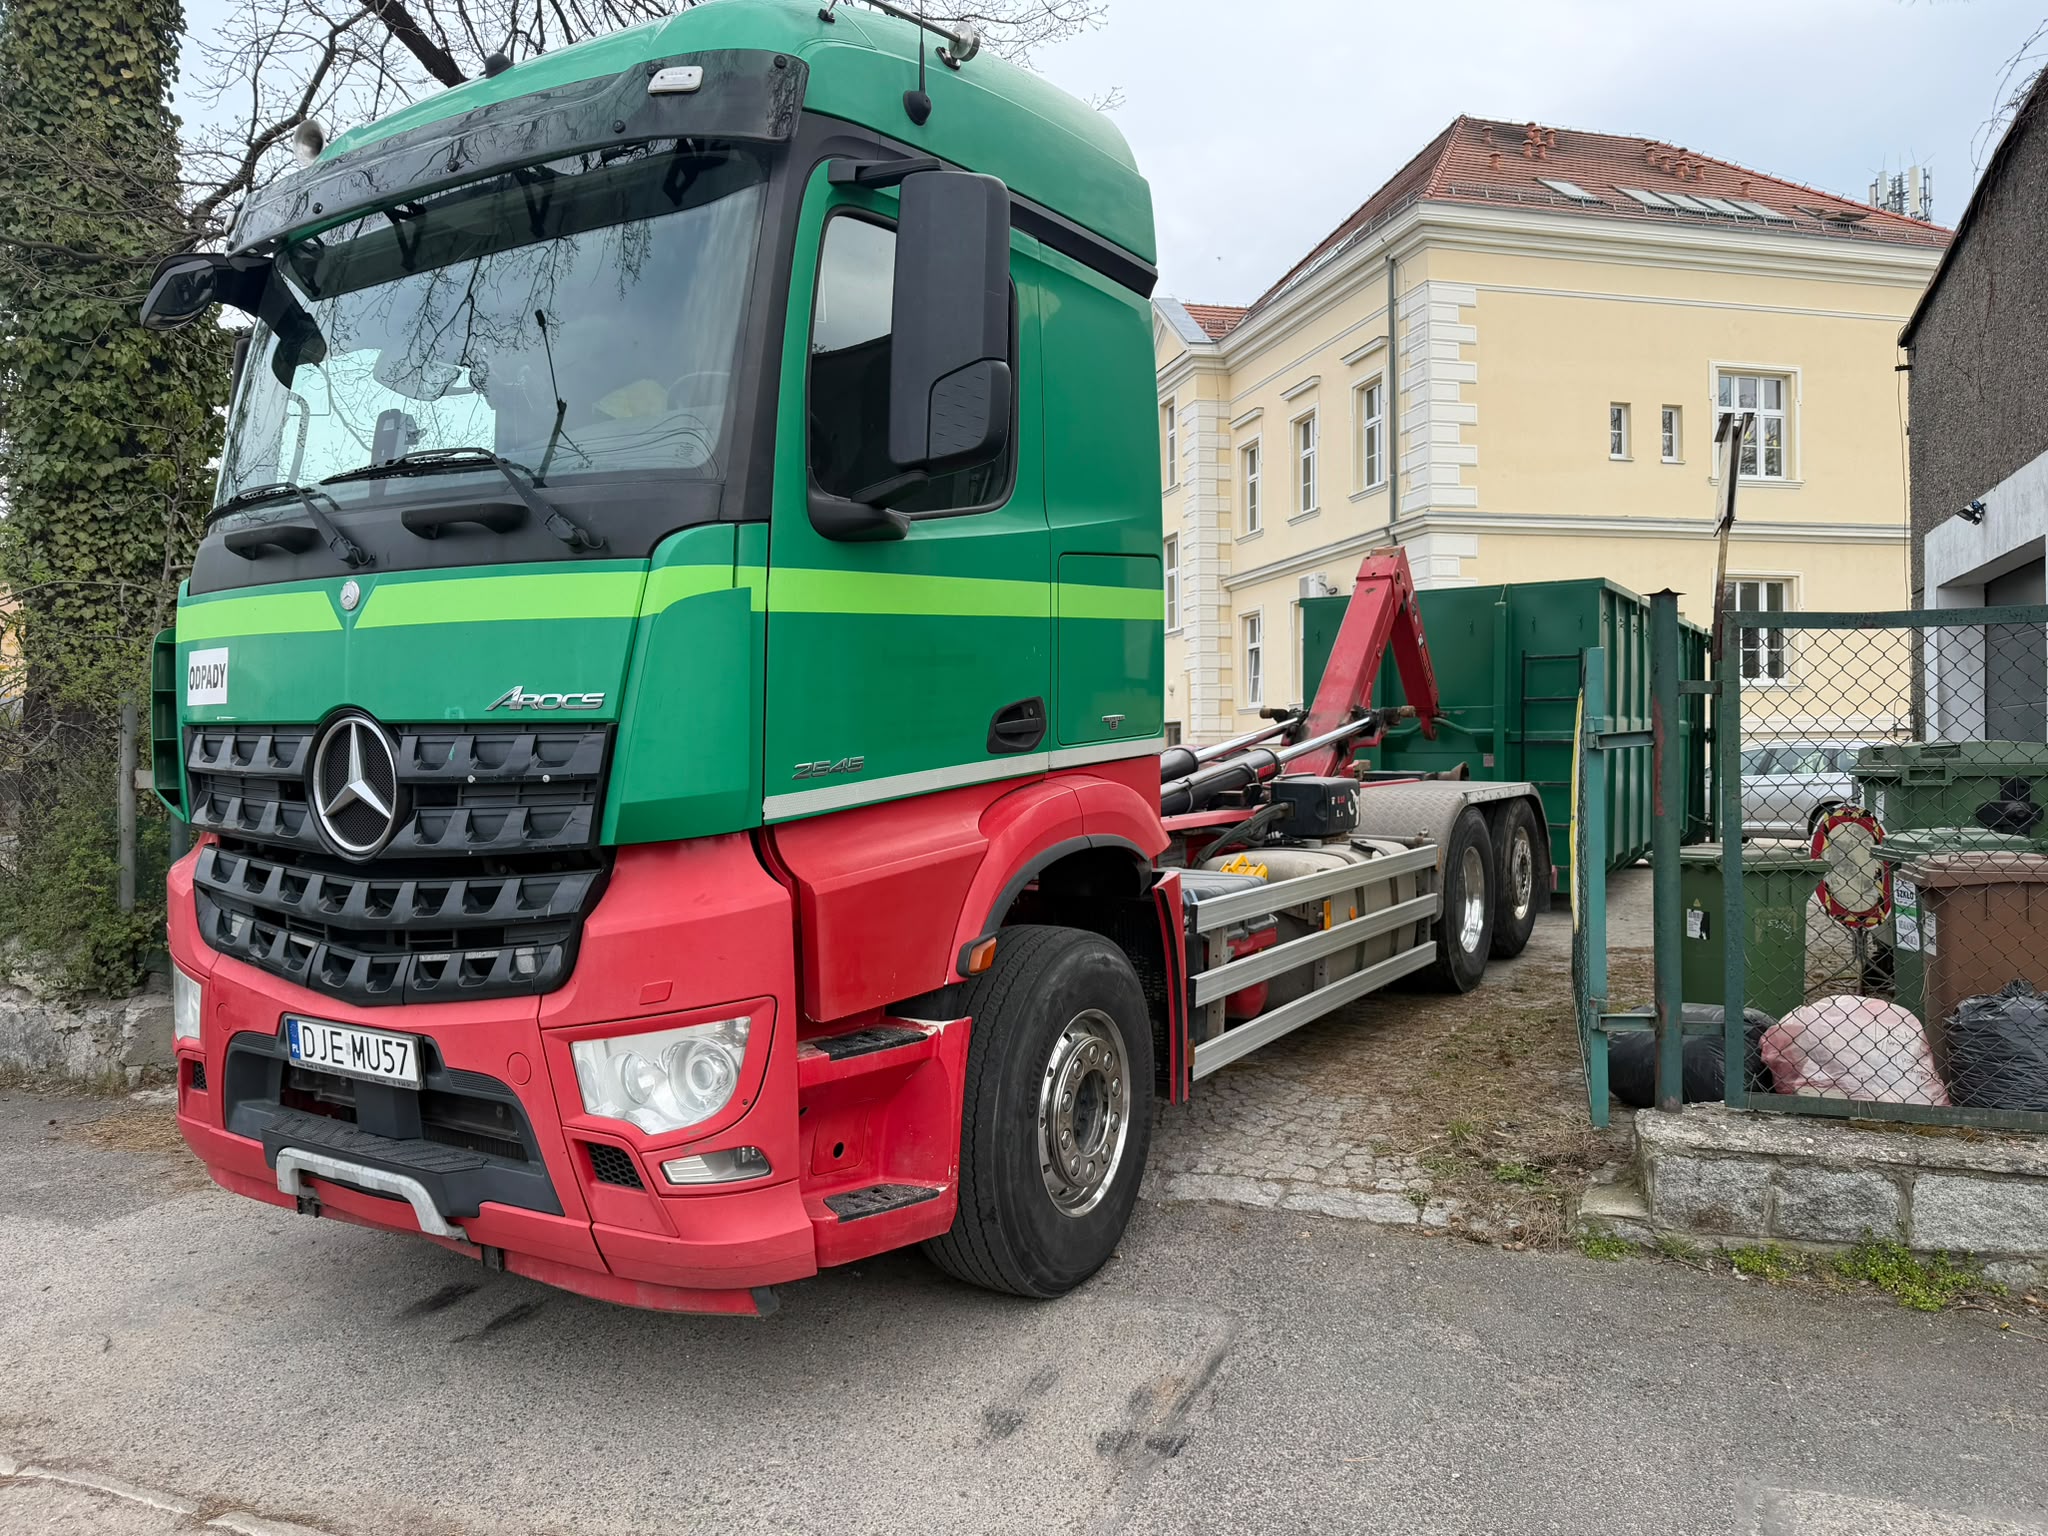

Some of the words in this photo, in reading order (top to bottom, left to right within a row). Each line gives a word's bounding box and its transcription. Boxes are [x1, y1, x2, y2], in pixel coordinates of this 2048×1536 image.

[189, 663, 226, 691] ODPADY
[791, 755, 865, 780] 2545
[291, 1043, 300, 1053] PL
[302, 1025, 345, 1065] DJE
[351, 1033, 408, 1076] MU57
